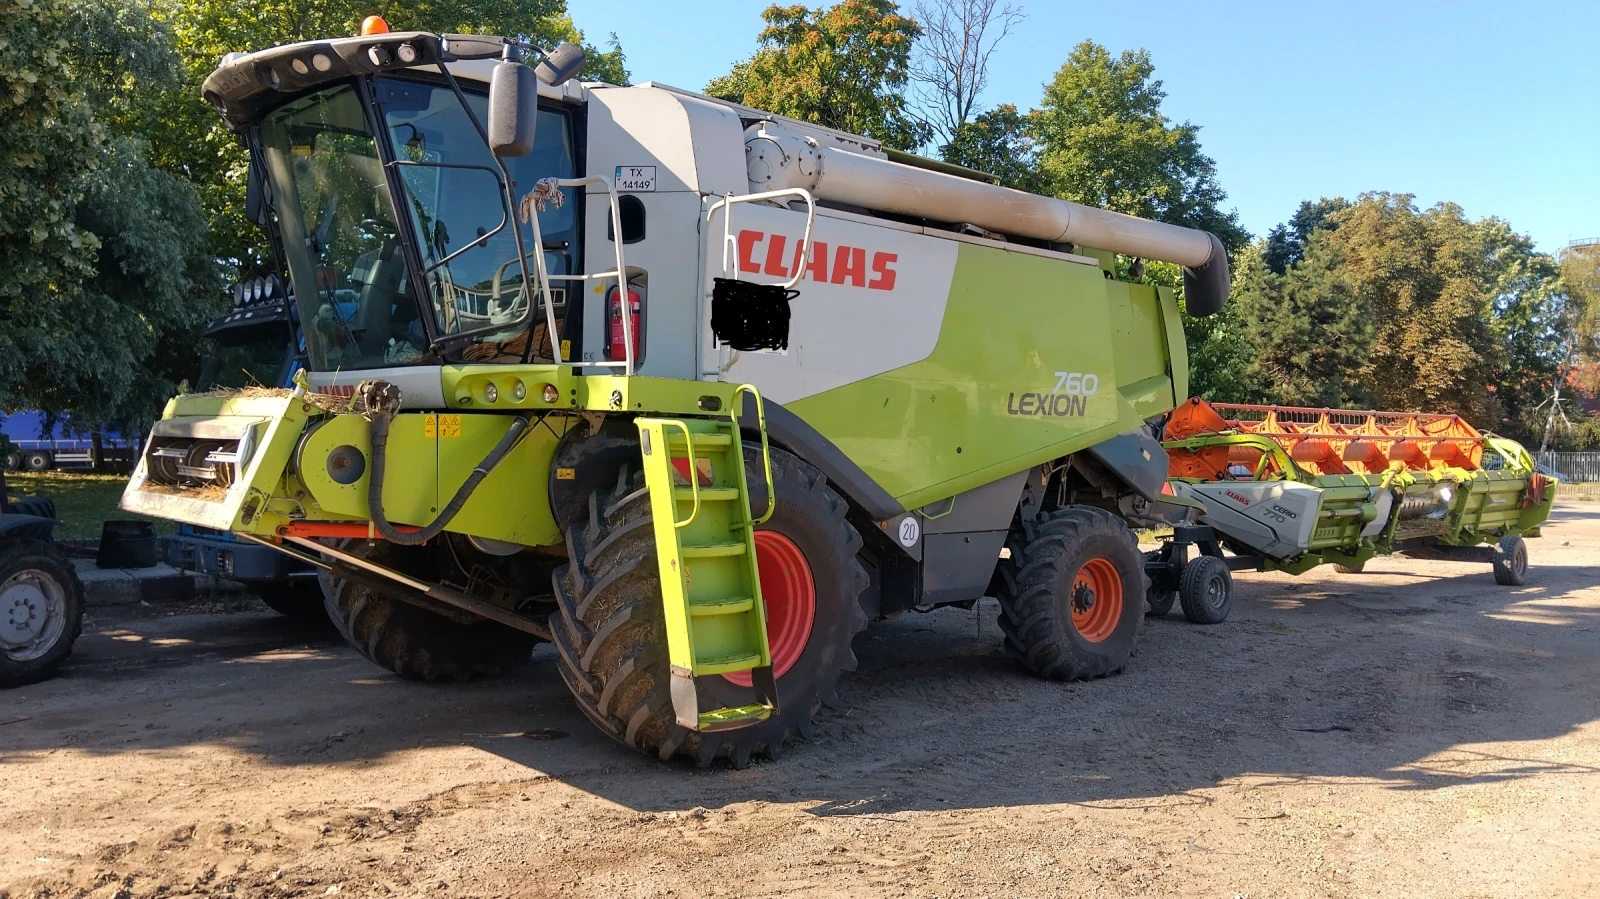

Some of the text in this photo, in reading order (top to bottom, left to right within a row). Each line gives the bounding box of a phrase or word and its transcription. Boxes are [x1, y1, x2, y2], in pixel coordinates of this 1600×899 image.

[630, 168, 643, 177] TX
[622, 180, 651, 189] 14149
[736, 229, 898, 291] CLAAS
[1051, 371, 1098, 395] 760
[1007, 392, 1087, 417] LEXION
[1226, 491, 1250, 505] CLAAS
[1263, 508, 1285, 523] 770
[1273, 505, 1297, 519] CERIO
[902, 522, 916, 541] 20
